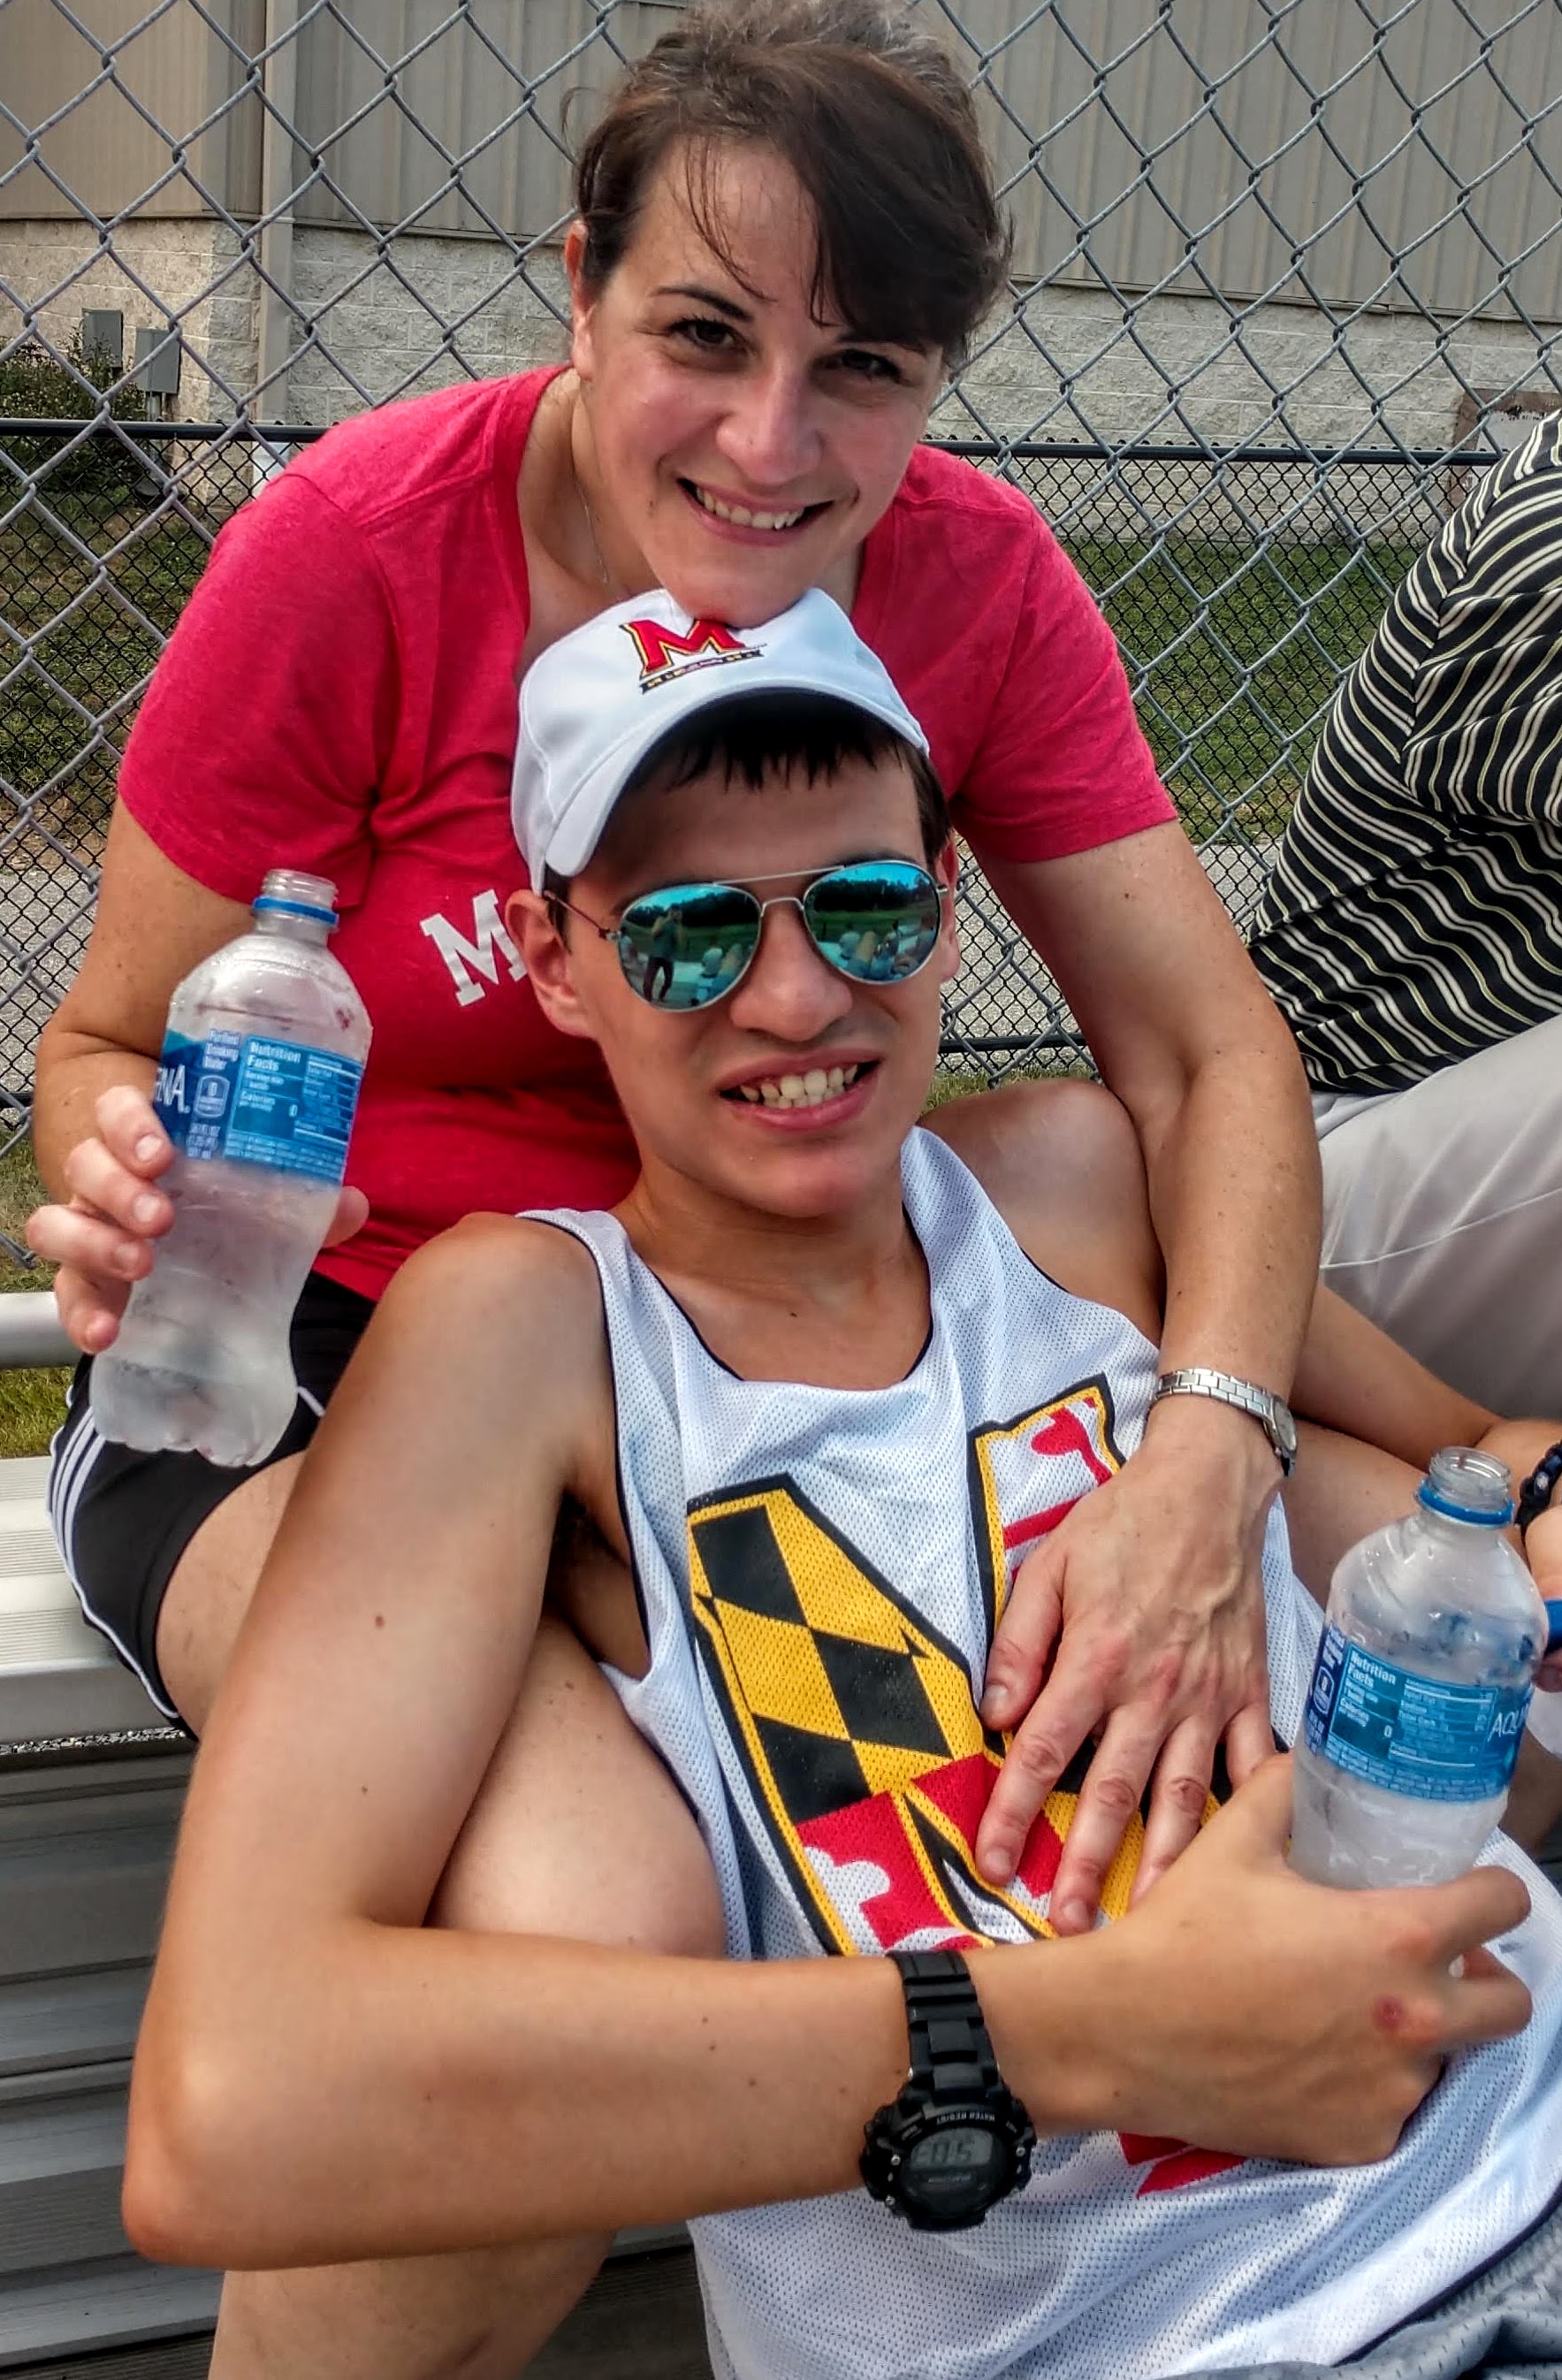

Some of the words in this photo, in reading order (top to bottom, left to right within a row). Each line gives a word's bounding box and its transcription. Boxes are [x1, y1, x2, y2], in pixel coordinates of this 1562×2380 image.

[619, 619, 748, 681] M
[419, 888, 528, 1007] M
[247, 1056, 279, 1072] Facts
[248, 1041, 301, 1064] Nutrition
[1347, 1663, 1375, 1690] Facts
[1350, 1650, 1397, 1685] Nutrition
